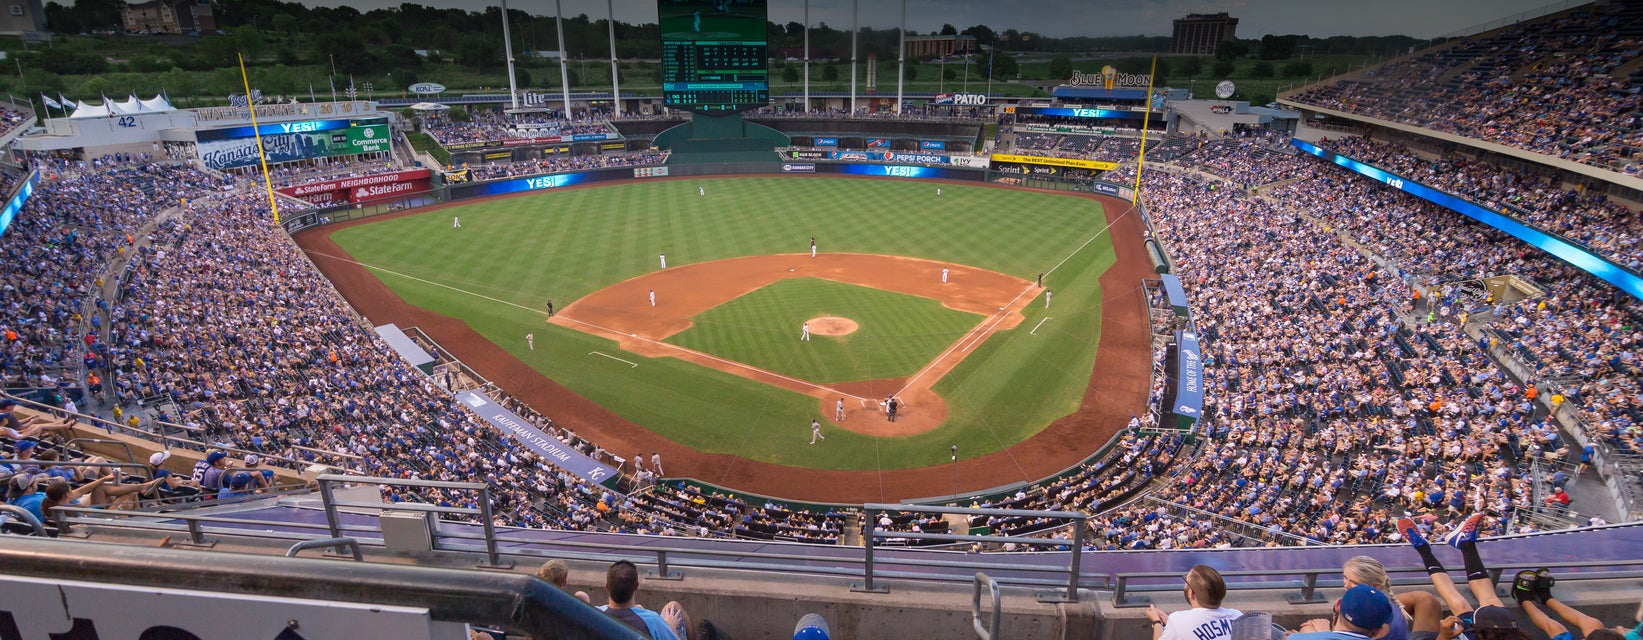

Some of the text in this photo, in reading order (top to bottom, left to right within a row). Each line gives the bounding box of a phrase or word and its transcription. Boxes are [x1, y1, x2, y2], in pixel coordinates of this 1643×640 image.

[1117, 73, 1151, 86] MOON
[954, 94, 986, 105] PATIO
[1073, 108, 1101, 118] YES!
[118, 116, 137, 128] 42
[281, 121, 316, 134] YES!
[262, 134, 290, 152] City
[352, 137, 387, 146] Commerce
[363, 144, 380, 152] Bank
[203, 142, 260, 169] Kansas
[896, 154, 915, 162] PEPSI
[884, 165, 911, 177] YES!
[998, 165, 1020, 175] Sprint
[1033, 166, 1050, 174] Sprint
[340, 174, 399, 188] NEIGHBORHOOD
[527, 178, 555, 190] YES!
[1186, 376, 1197, 393] HOME
[492, 414, 572, 462] KAUFFMAN STADIUM
[587, 466, 606, 480] KC
[1193, 618, 1233, 640] HOSM
